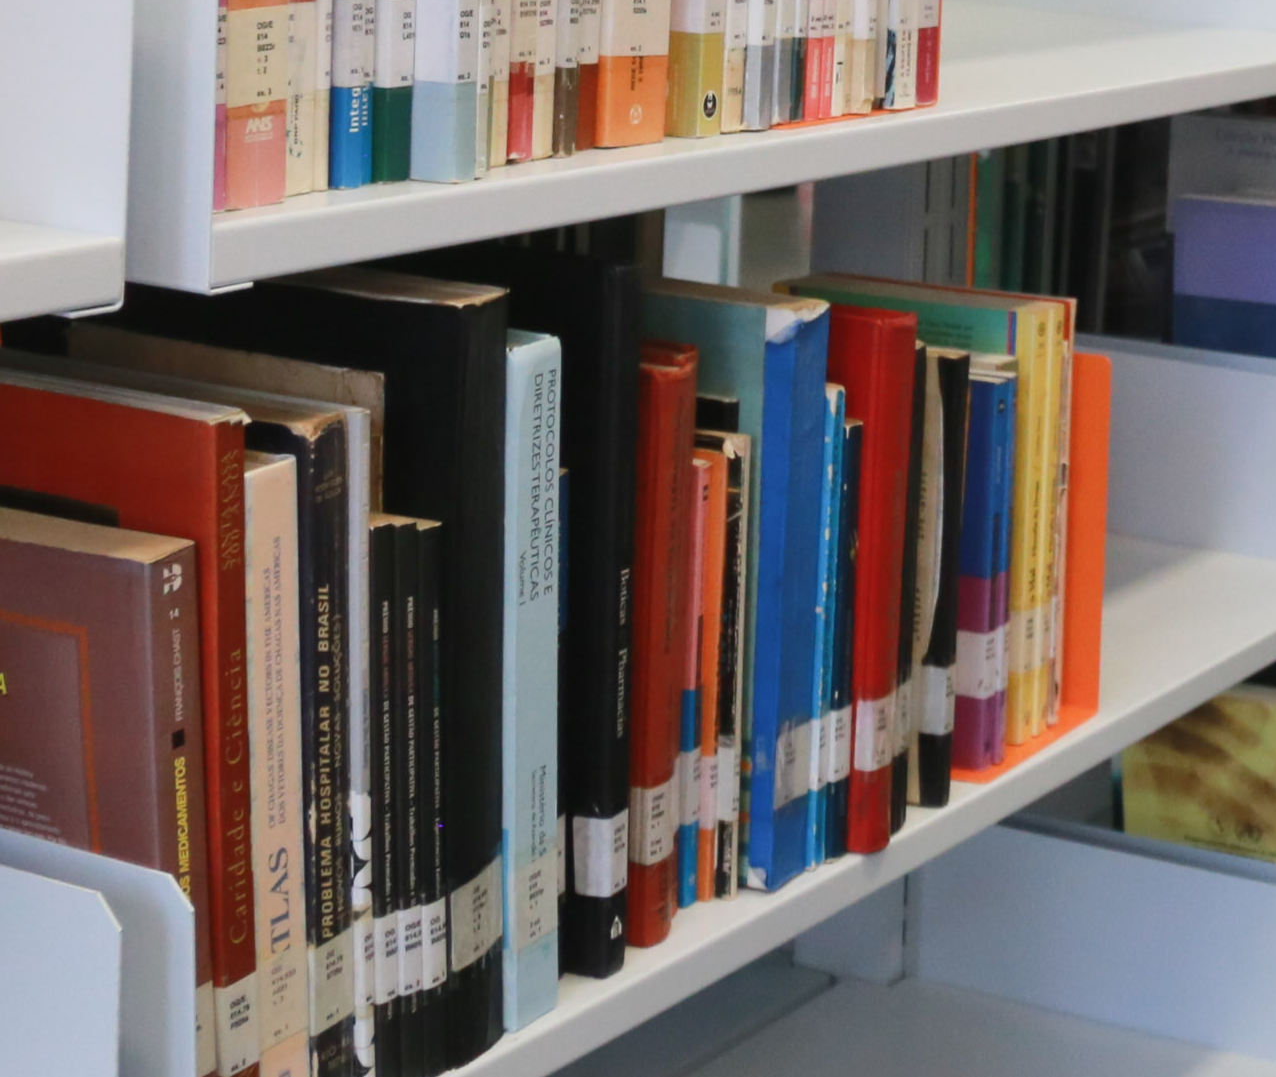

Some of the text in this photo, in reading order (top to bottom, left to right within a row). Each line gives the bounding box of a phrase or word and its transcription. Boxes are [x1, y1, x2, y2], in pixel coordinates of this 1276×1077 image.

[350, 87, 362, 132] Integ
[529, 373, 545, 602] DIRETRIZES TERAPÊUTICAS
[542, 368, 557, 596] PROTOCOLOS CLÍNICOS E
[169, 607, 180, 621] 14
[518, 550, 528, 599] Volume
[171, 628, 182, 664] CHAST
[616, 567, 630, 740] Boticas Pharmacias
[173, 665, 185, 722] FRANÇOIS
[223, 648, 247, 944] Caridade e Ciência
[316, 583, 334, 939] PROBLEMA HOSPITALAR NO BRASIL
[538, 764, 548, 827] Ministério
[174, 757, 191, 873] MEDICAMENTOS
[538, 830, 547, 845] da
[267, 846, 291, 953] TLAS
